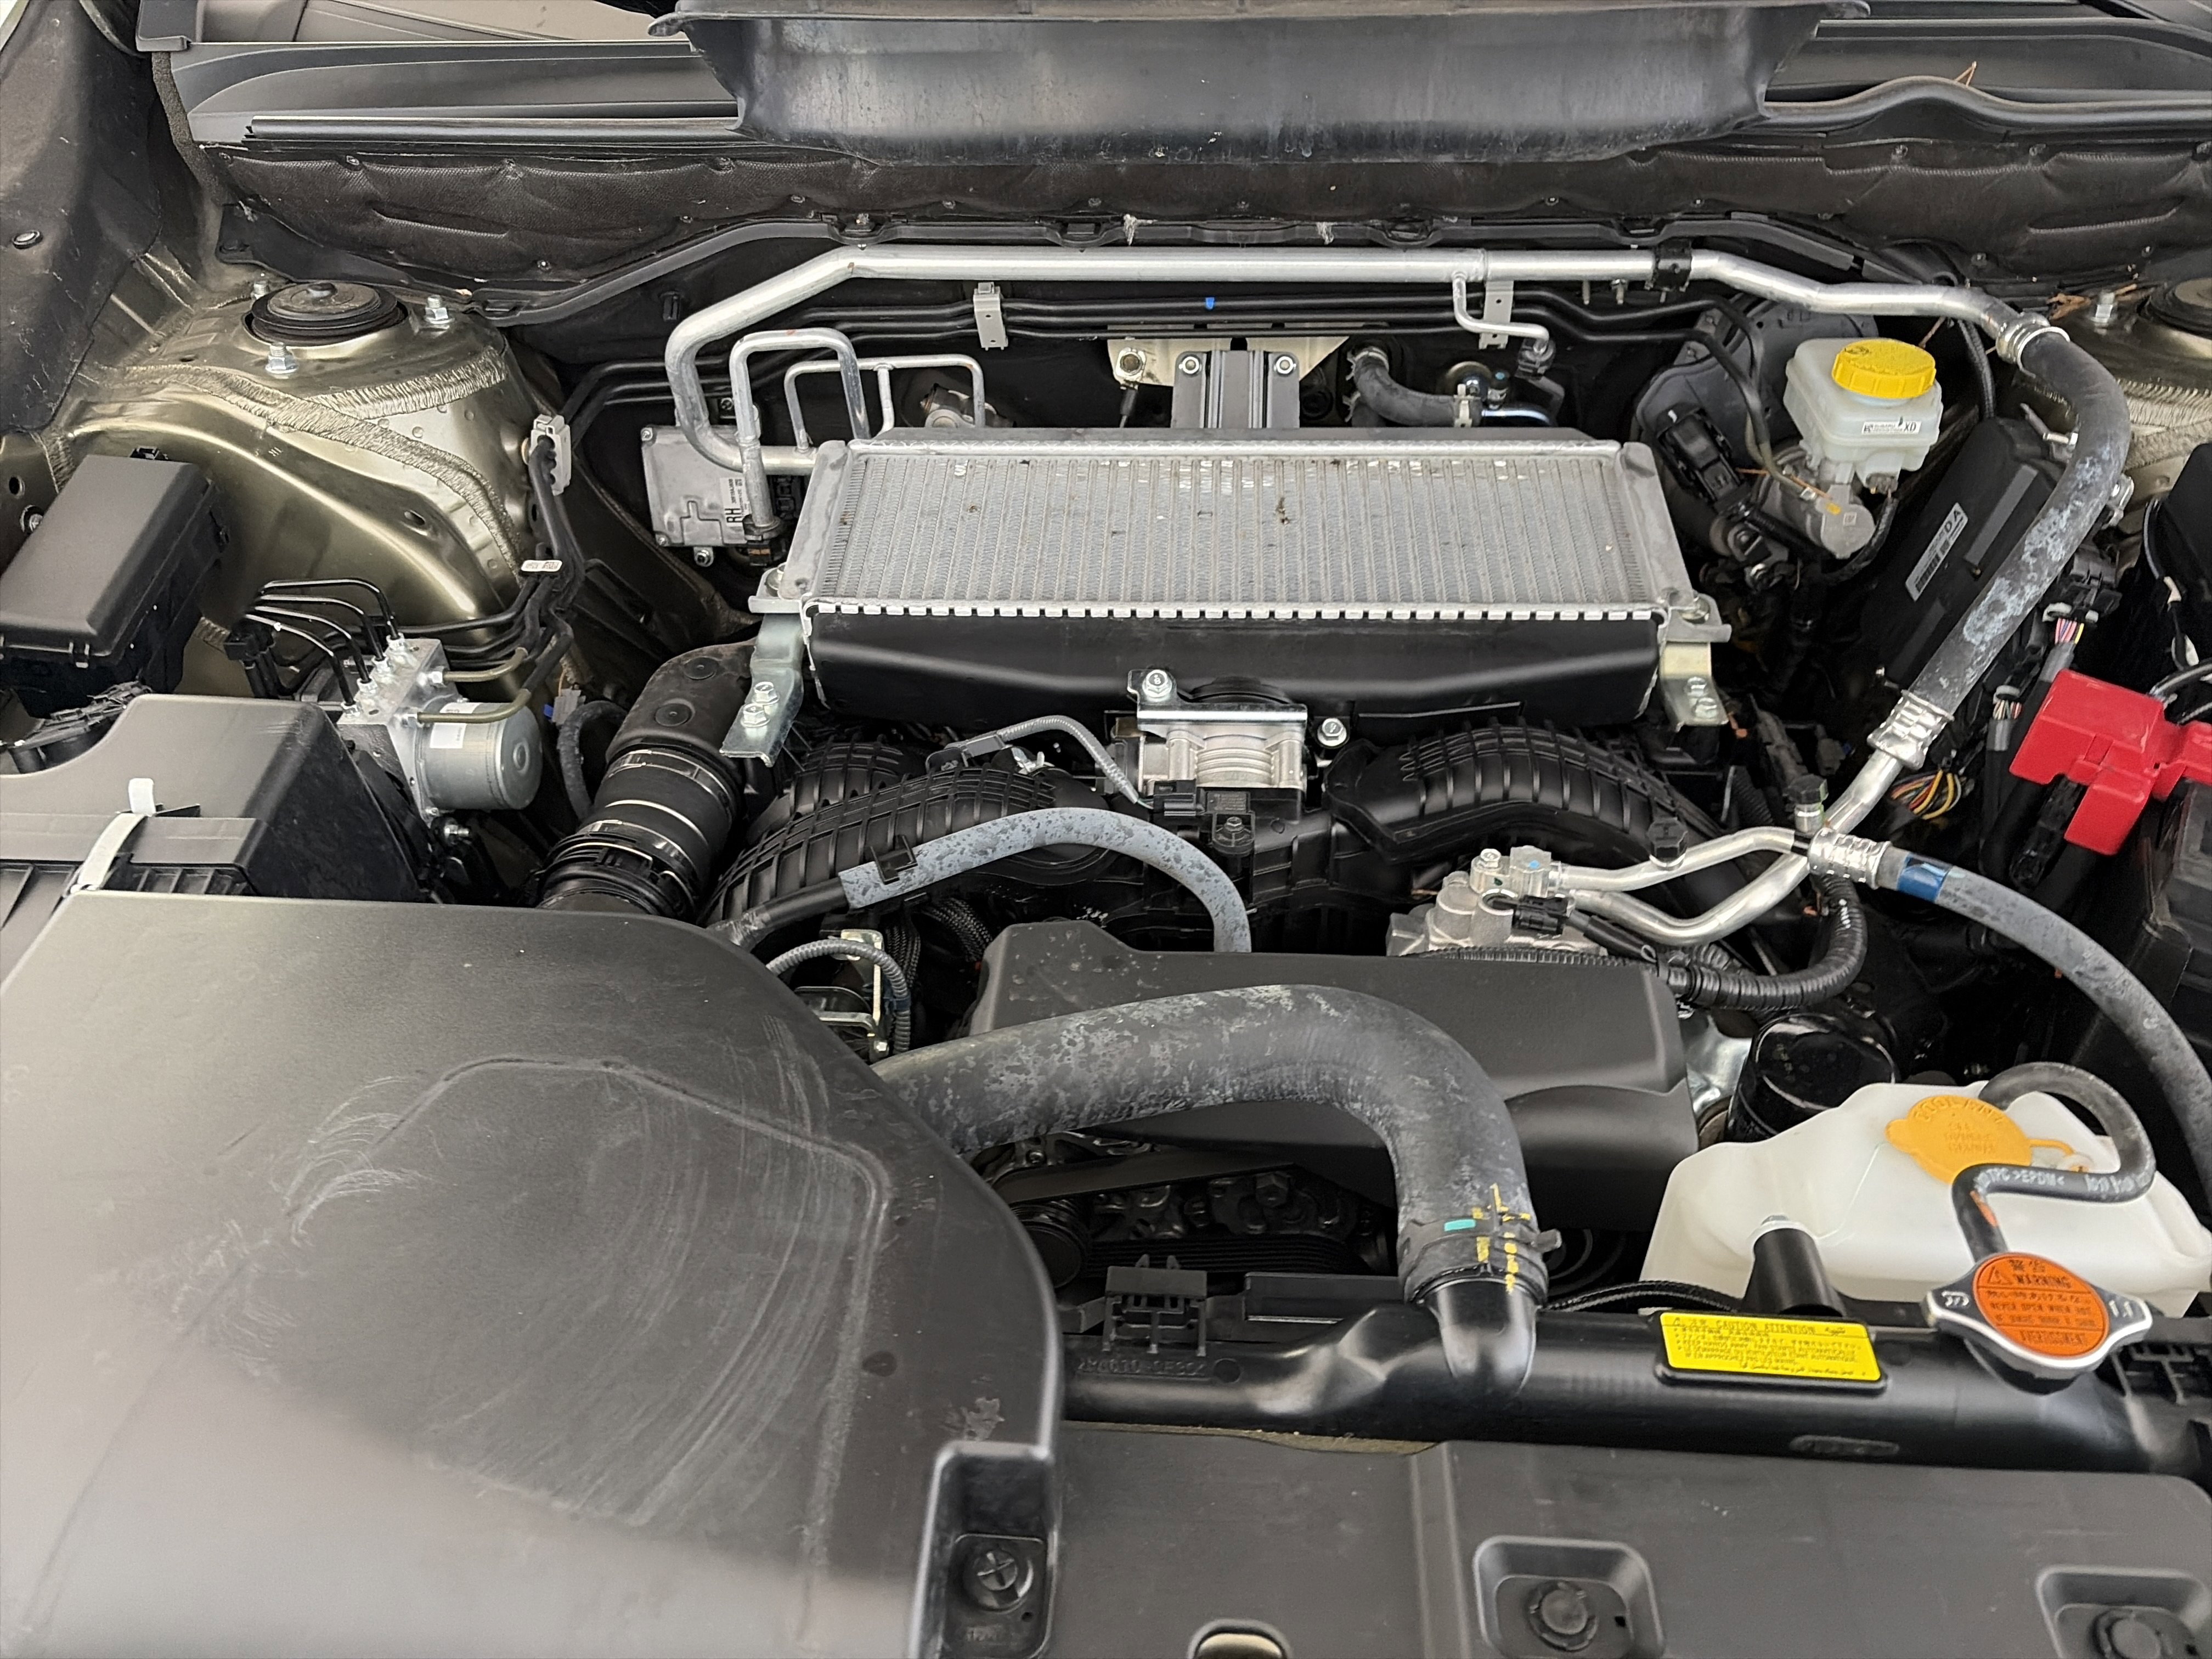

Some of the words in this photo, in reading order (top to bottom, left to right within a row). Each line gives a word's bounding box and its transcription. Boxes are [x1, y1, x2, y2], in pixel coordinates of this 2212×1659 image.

[1904, 421, 1917, 433] XD
[724, 508, 743, 523] RH
[1716, 1319, 1758, 1330] CAUTION
